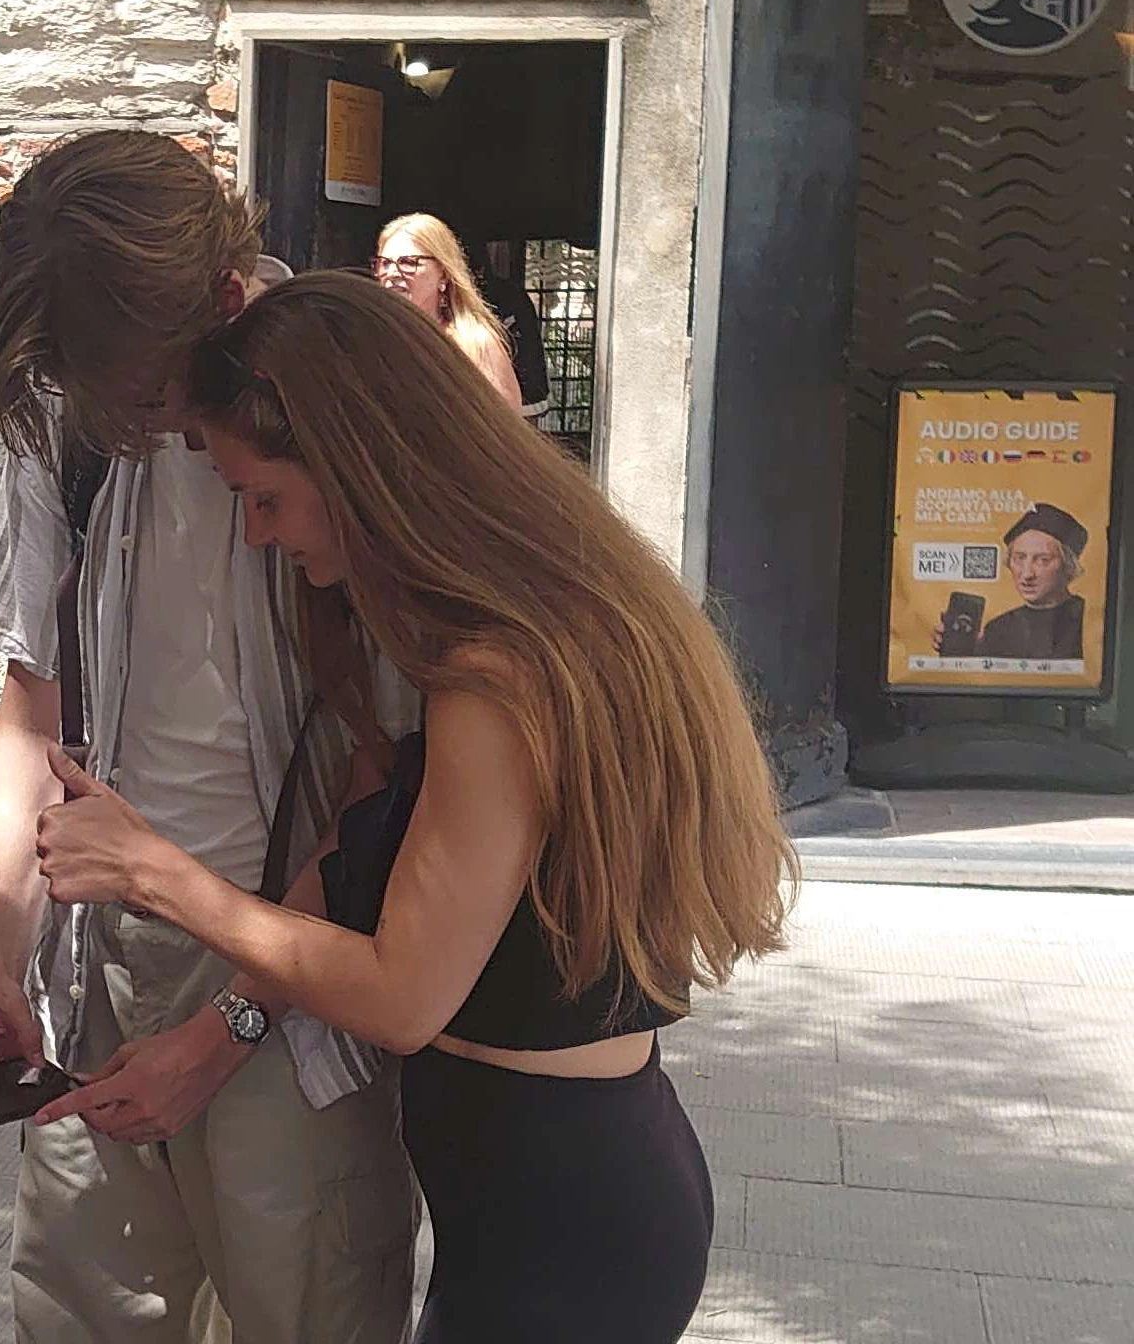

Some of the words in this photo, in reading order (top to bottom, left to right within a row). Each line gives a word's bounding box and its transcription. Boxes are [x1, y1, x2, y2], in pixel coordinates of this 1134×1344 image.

[921, 421, 999, 440] AUDIO
[1005, 422, 1080, 441] GUIDE
[916, 488, 986, 500] ANDIAMO
[989, 489, 1024, 501] ALLA
[915, 511, 942, 523] MIA
[919, 550, 945, 559] SCAN
[919, 561, 945, 573] ME!
